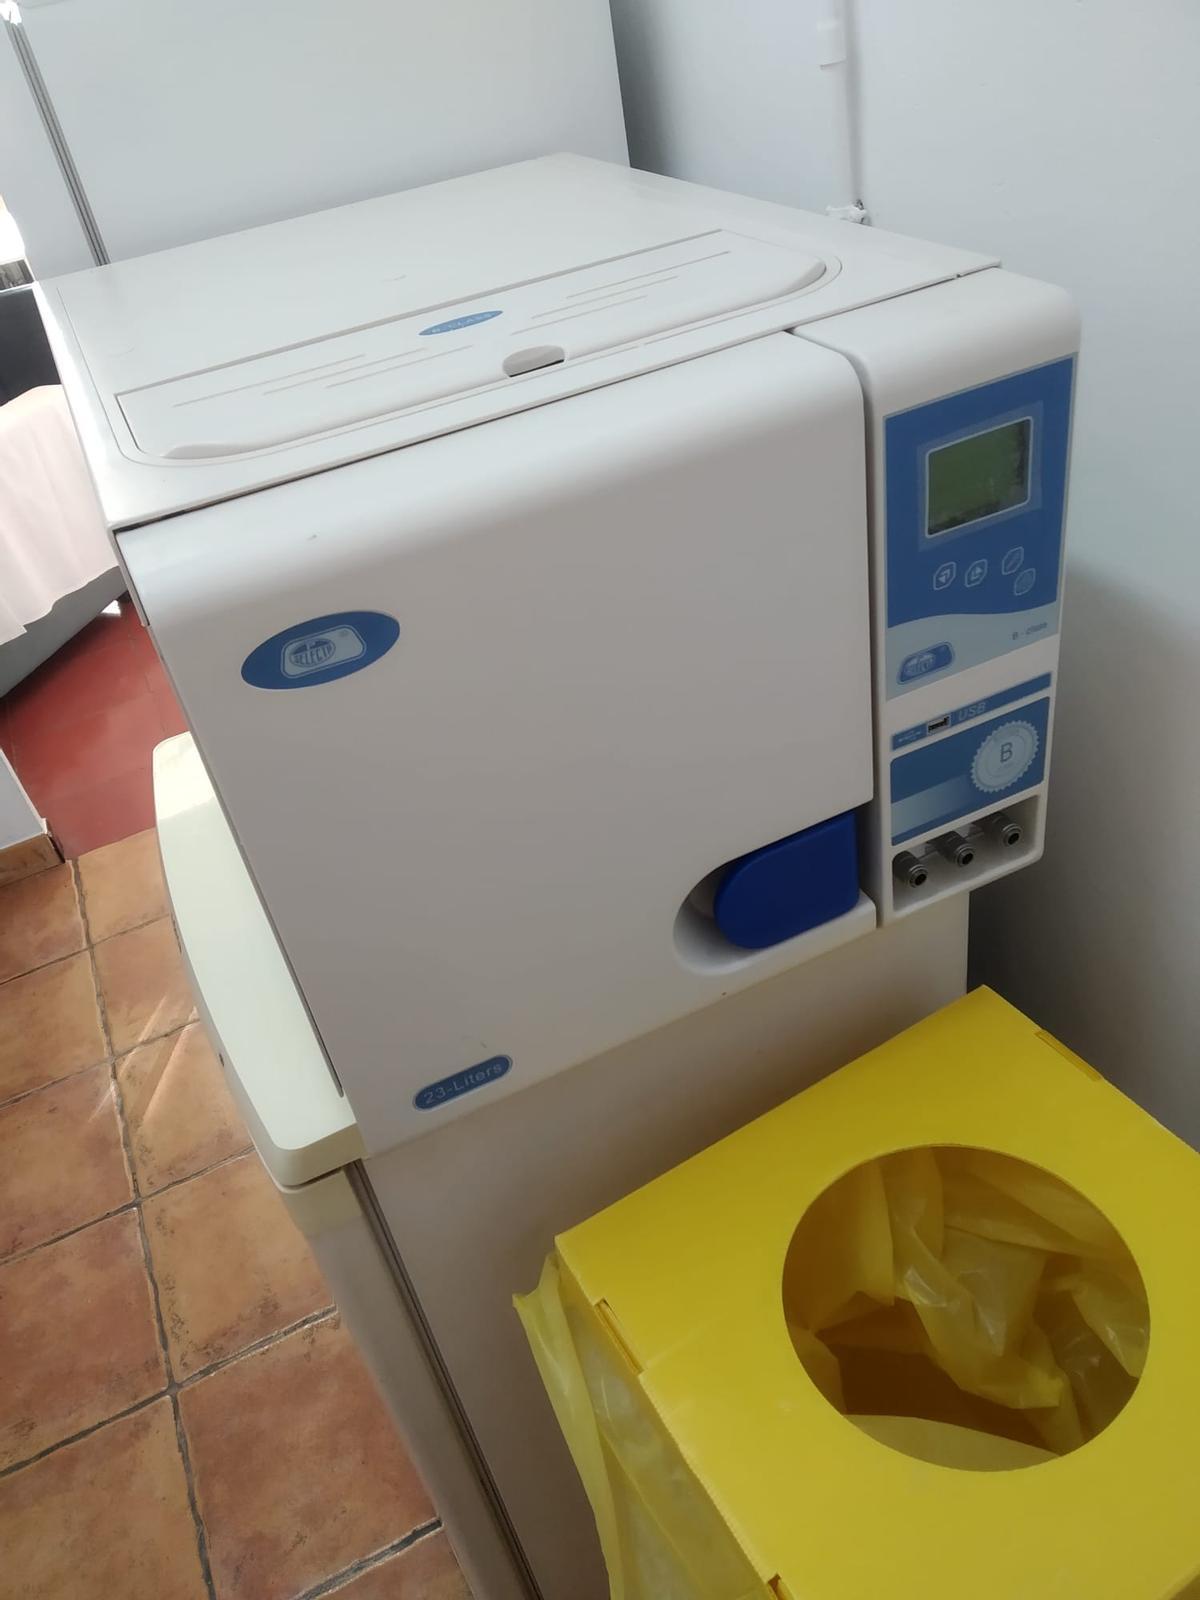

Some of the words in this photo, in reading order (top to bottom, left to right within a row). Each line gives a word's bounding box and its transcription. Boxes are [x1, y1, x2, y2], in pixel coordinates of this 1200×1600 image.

[958, 702, 986, 721] USB
[1000, 742, 1013, 763] B
[424, 1063, 502, 1104] 23-Liters
